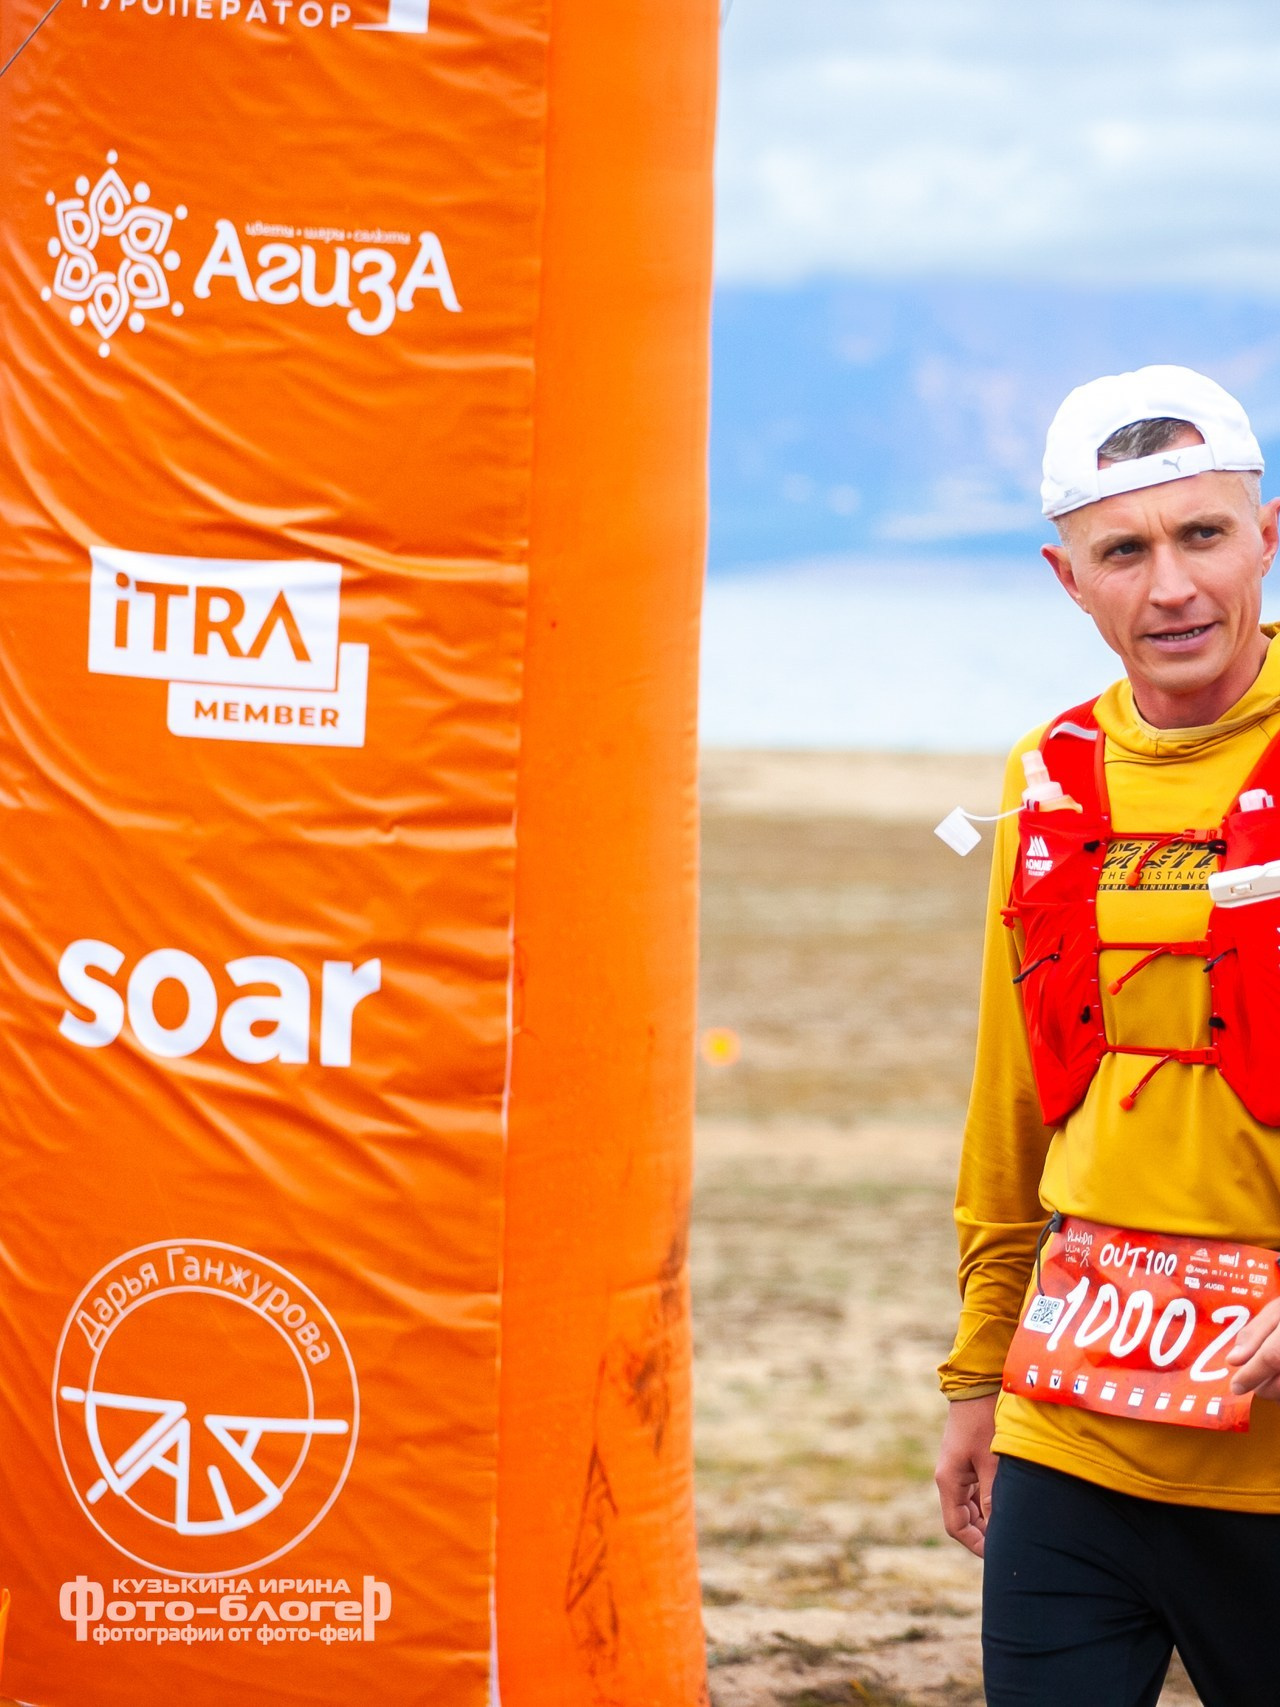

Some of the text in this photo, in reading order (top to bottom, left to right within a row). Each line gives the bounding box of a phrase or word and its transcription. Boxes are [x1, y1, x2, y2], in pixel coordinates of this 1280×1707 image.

[194, 699, 340, 729] MEMBER
[1101, 870, 1127, 880] THE
[57, 938, 382, 1068] soar
[76, 1247, 331, 1365] Дарья Ганжурова
[1046, 1276, 1251, 1383] 10002
